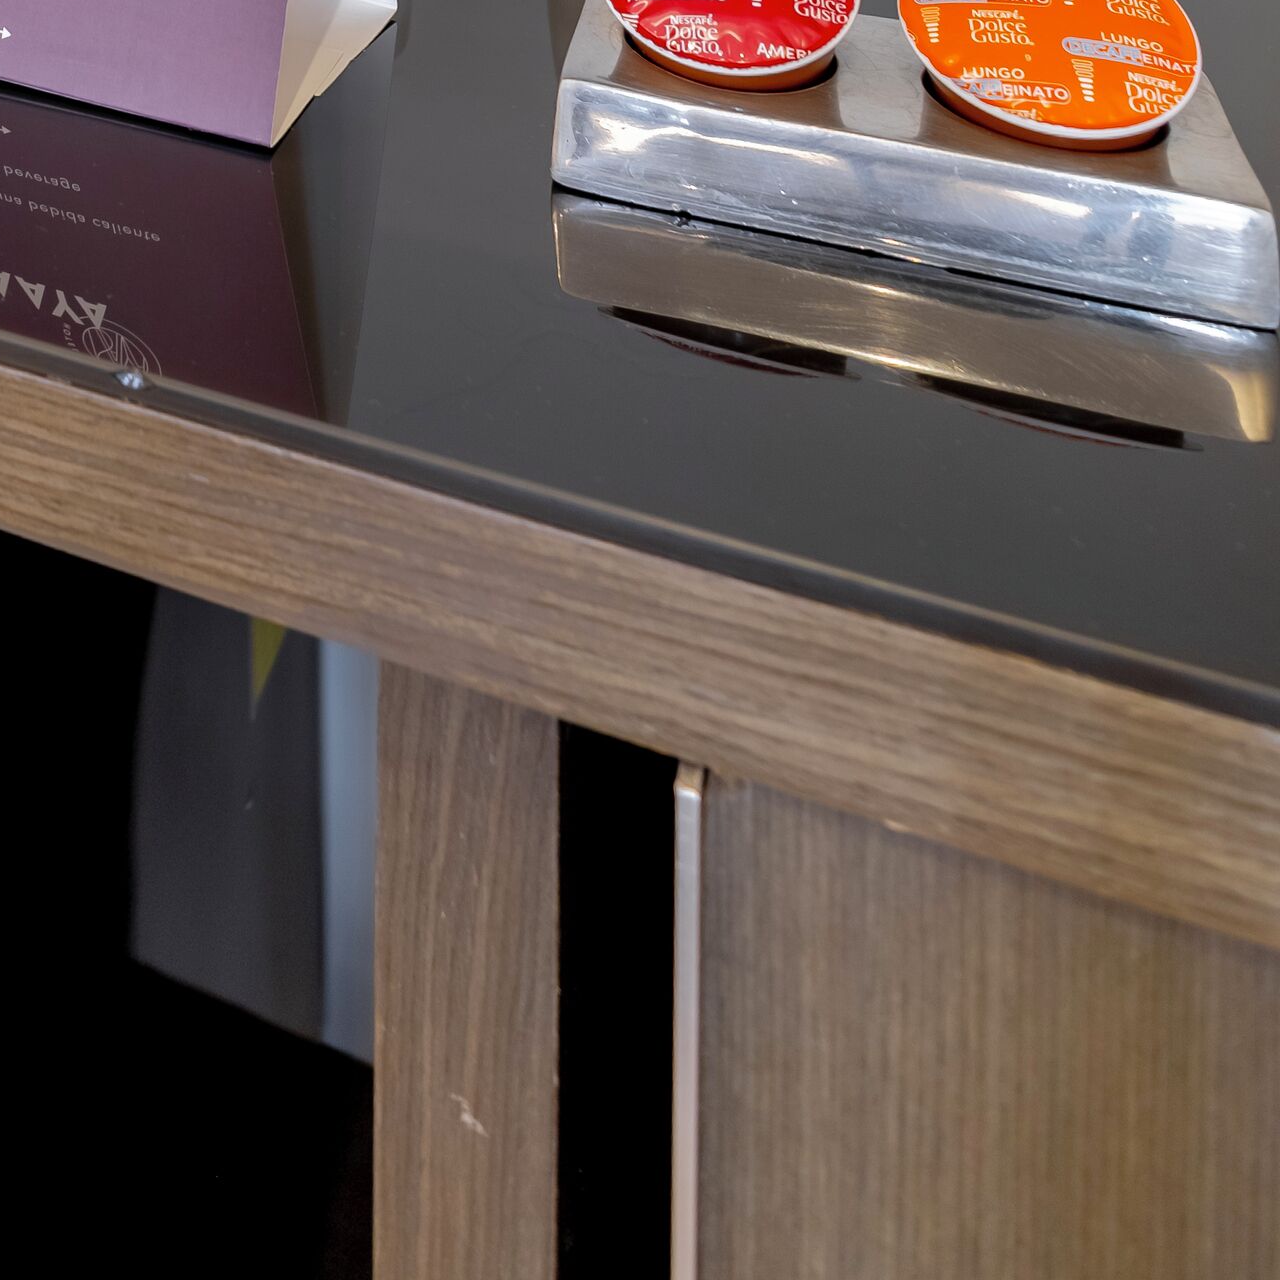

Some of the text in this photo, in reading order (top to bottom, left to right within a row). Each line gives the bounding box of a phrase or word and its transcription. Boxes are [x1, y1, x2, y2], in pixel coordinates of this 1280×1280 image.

[793, 0, 850, 25] Gusto
[1106, 2, 1167, 25] Gusto
[665, 23, 718, 40] Dolce
[968, 17, 1028, 33] Dolce
[970, 31, 1031, 45] Gusto
[1100, 31, 1164, 52] LUNGO
[665, 39, 721, 55] Gusto
[960, 66, 1025, 80] LUNGO
[1128, 96, 1173, 114] Gus
